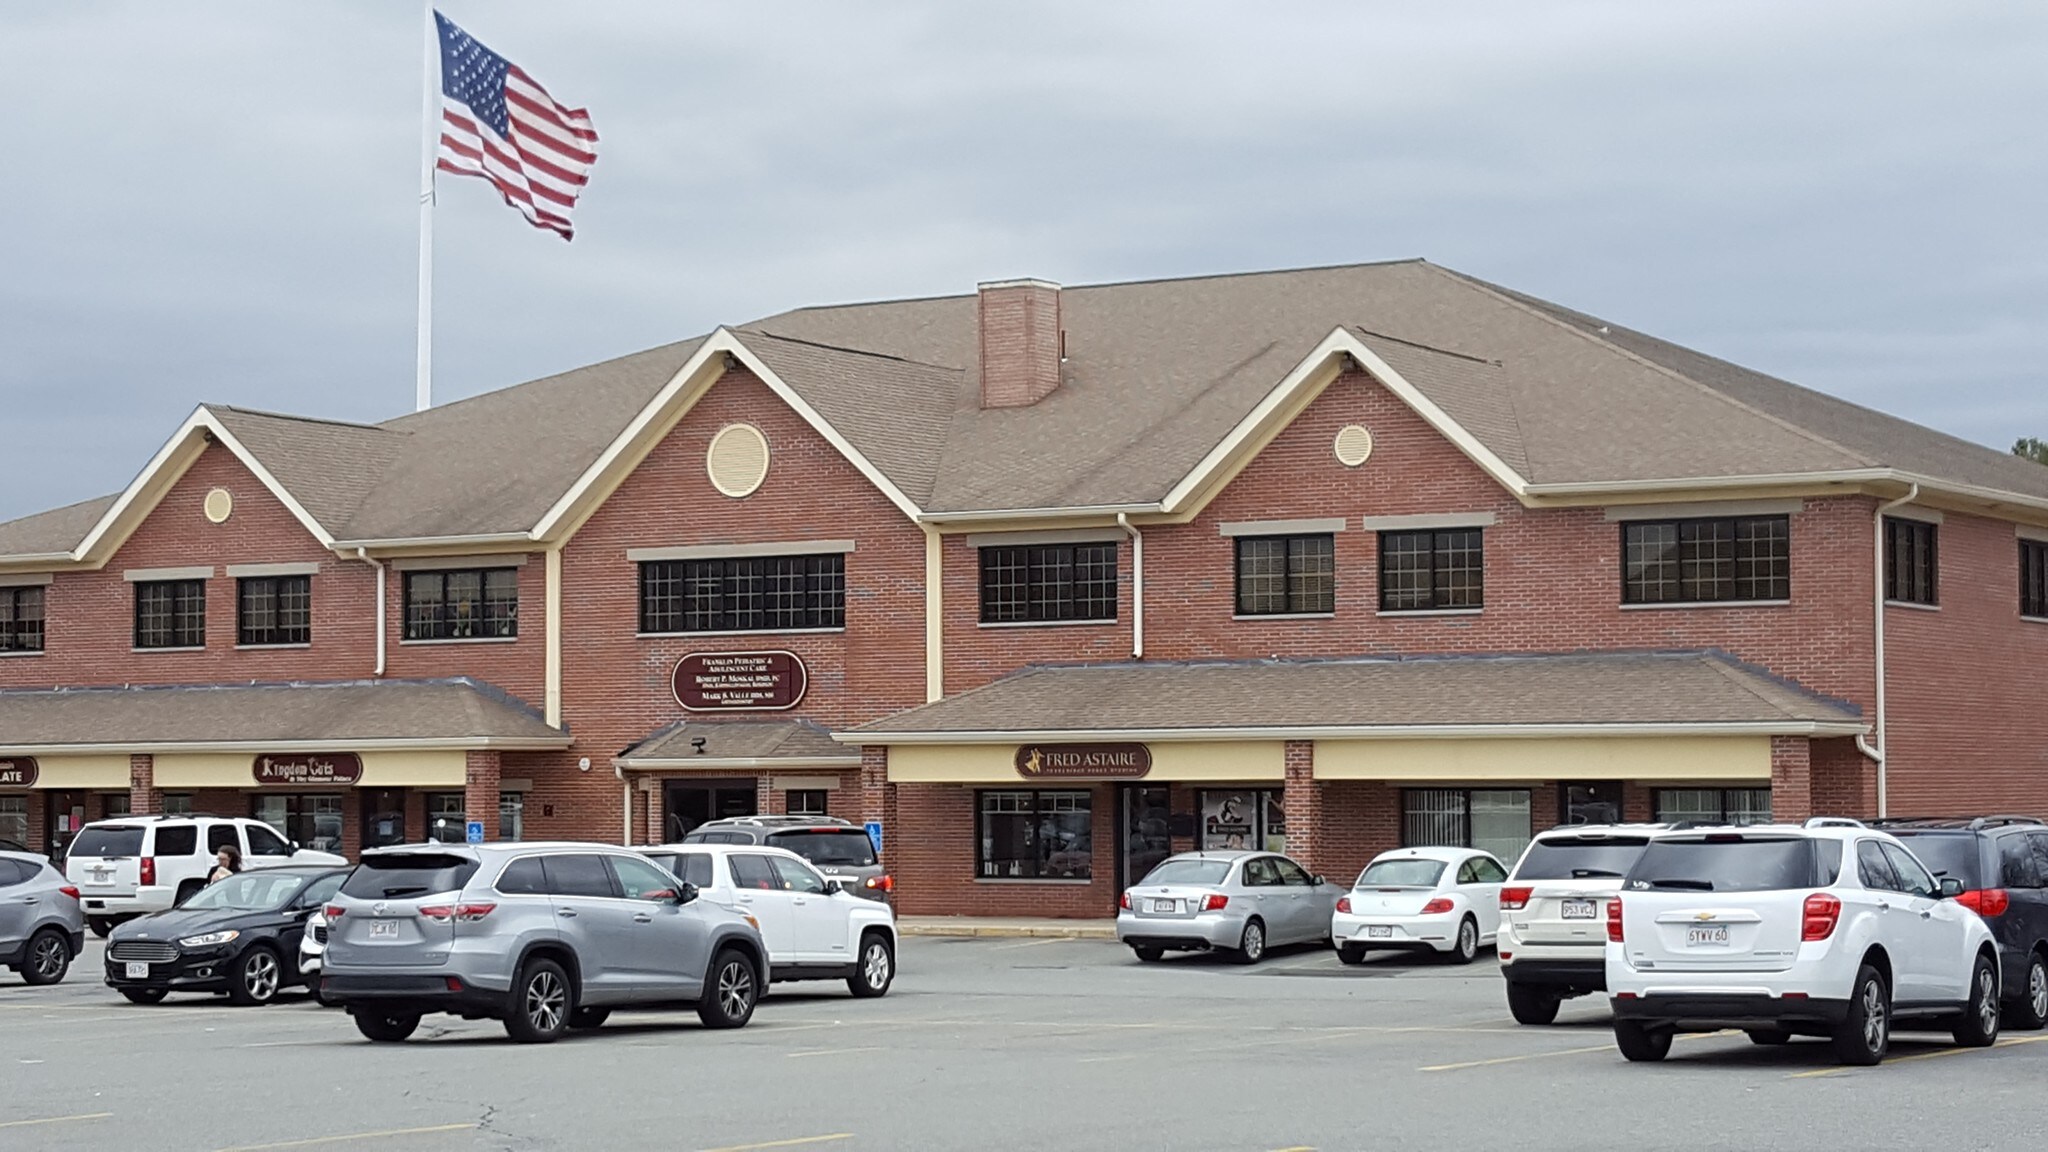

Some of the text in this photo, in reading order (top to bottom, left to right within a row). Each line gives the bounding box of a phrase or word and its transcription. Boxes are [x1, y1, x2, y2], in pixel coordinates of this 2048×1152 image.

[767, 657, 773, 665] &
[695, 675, 720, 683] ROBERT
[1046, 752, 1137, 767] FRED ASTAIRE
[262, 756, 334, 780] Kingdom Cuts
